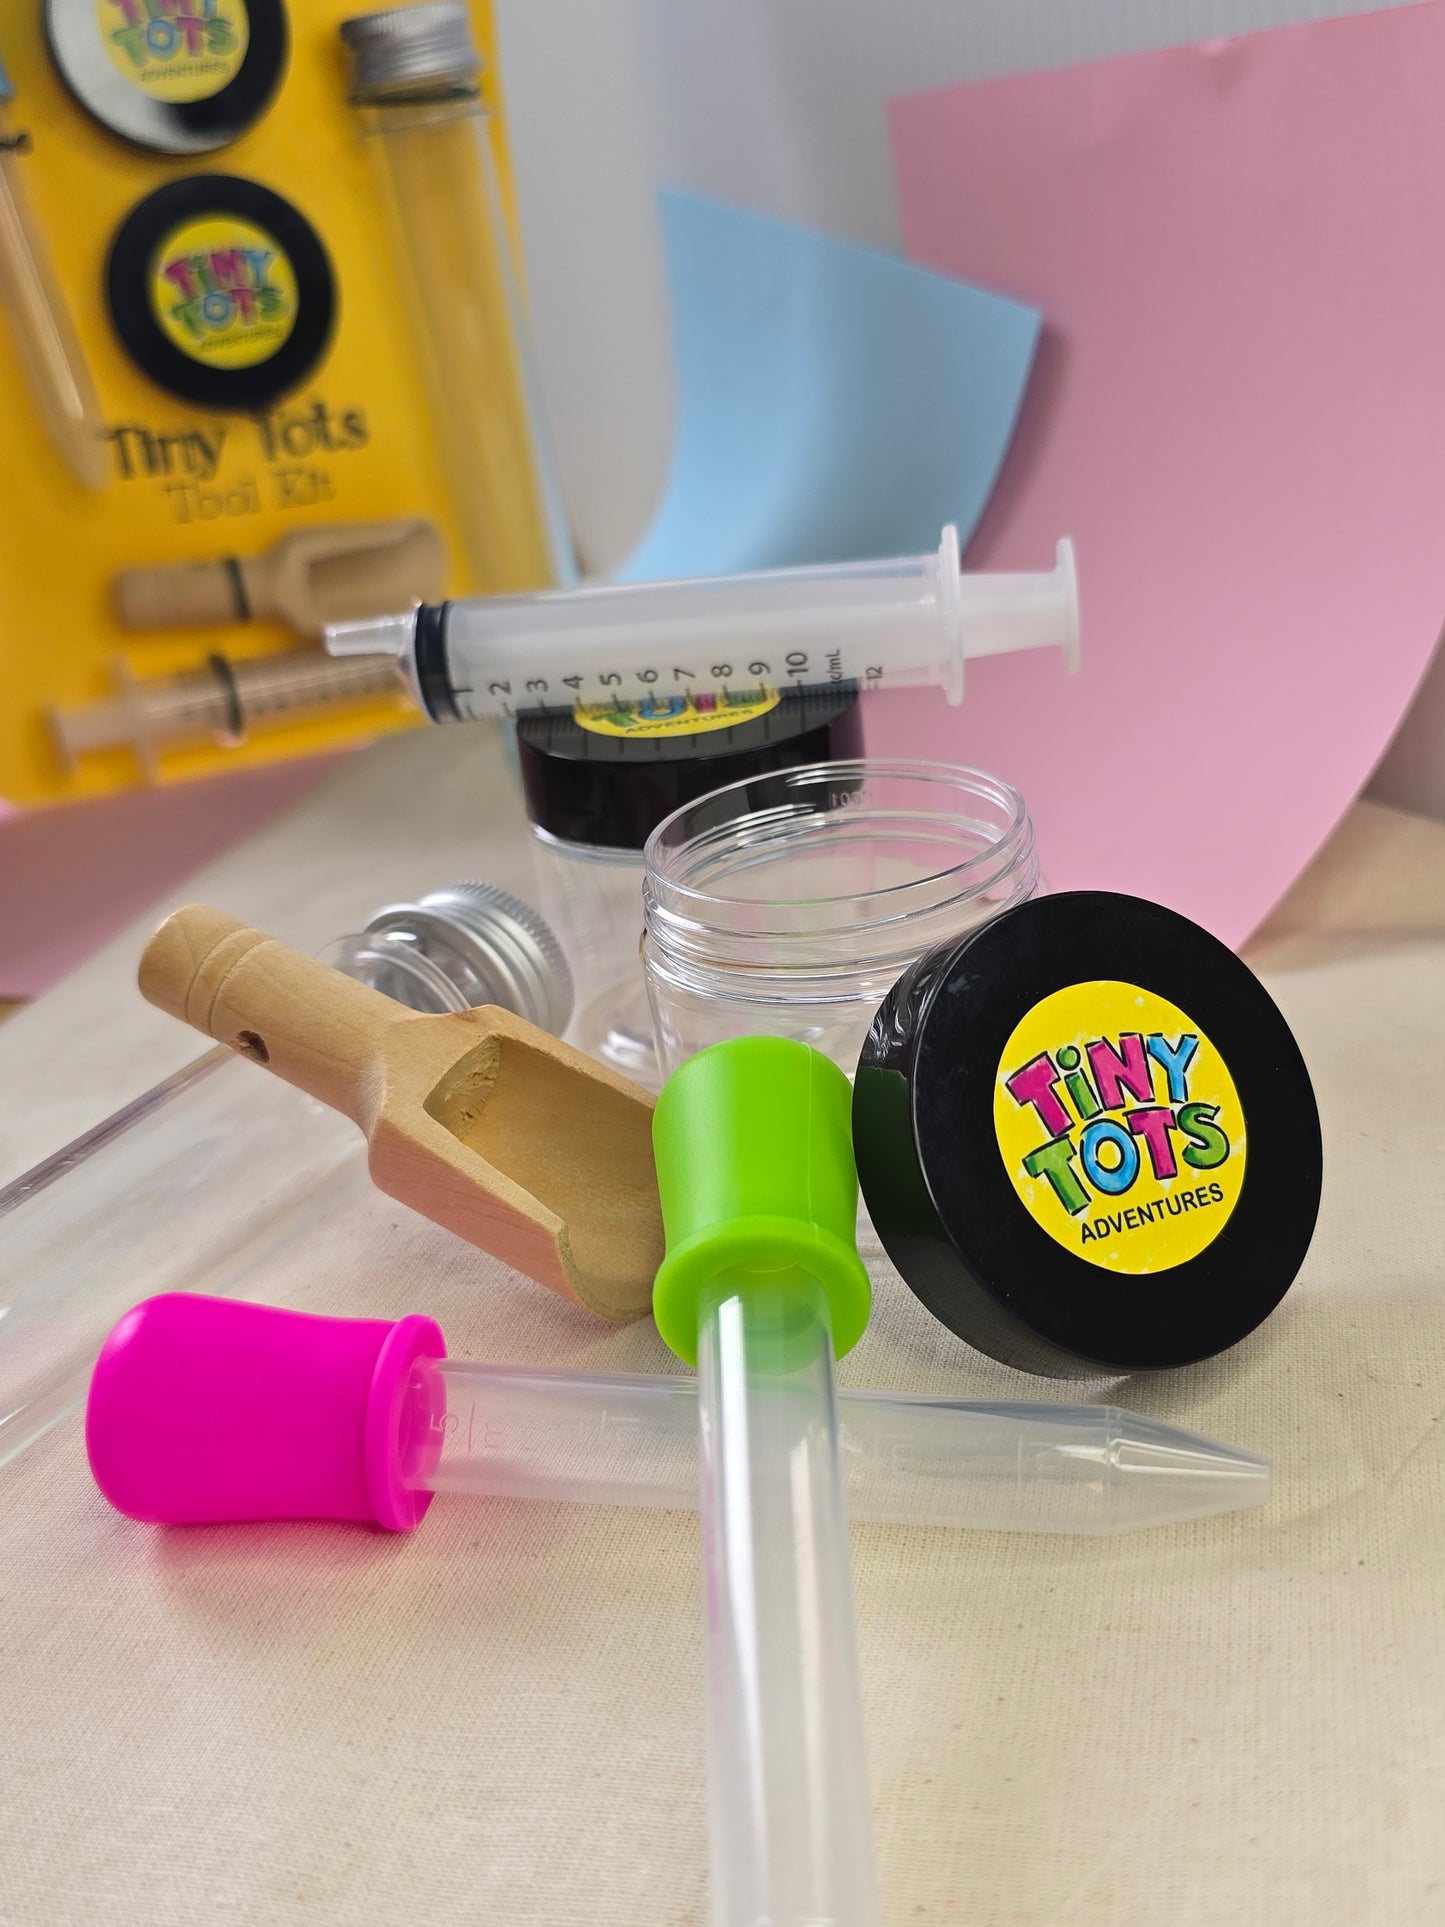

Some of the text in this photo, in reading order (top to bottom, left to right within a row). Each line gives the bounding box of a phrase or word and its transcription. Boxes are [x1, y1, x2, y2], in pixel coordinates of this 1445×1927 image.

[112, 16, 236, 67] TOTS
[172, 287, 286, 340] TOTS
[106, 427, 227, 481] Tiny
[710, 664, 733, 678] 8
[748, 661, 772, 676] 9
[785, 652, 808, 678] 10
[599, 673, 622, 686] 5
[636, 669, 659, 684] 6
[673, 667, 696, 681] 7
[489, 681, 513, 696] 2
[526, 679, 549, 693] 3
[562, 675, 584, 690] 4
[625, 707, 754, 734] ADVENTURES
[1022, 1102, 1230, 1216] TOTS
[1081, 1182, 1224, 1244] ADVENTURES
